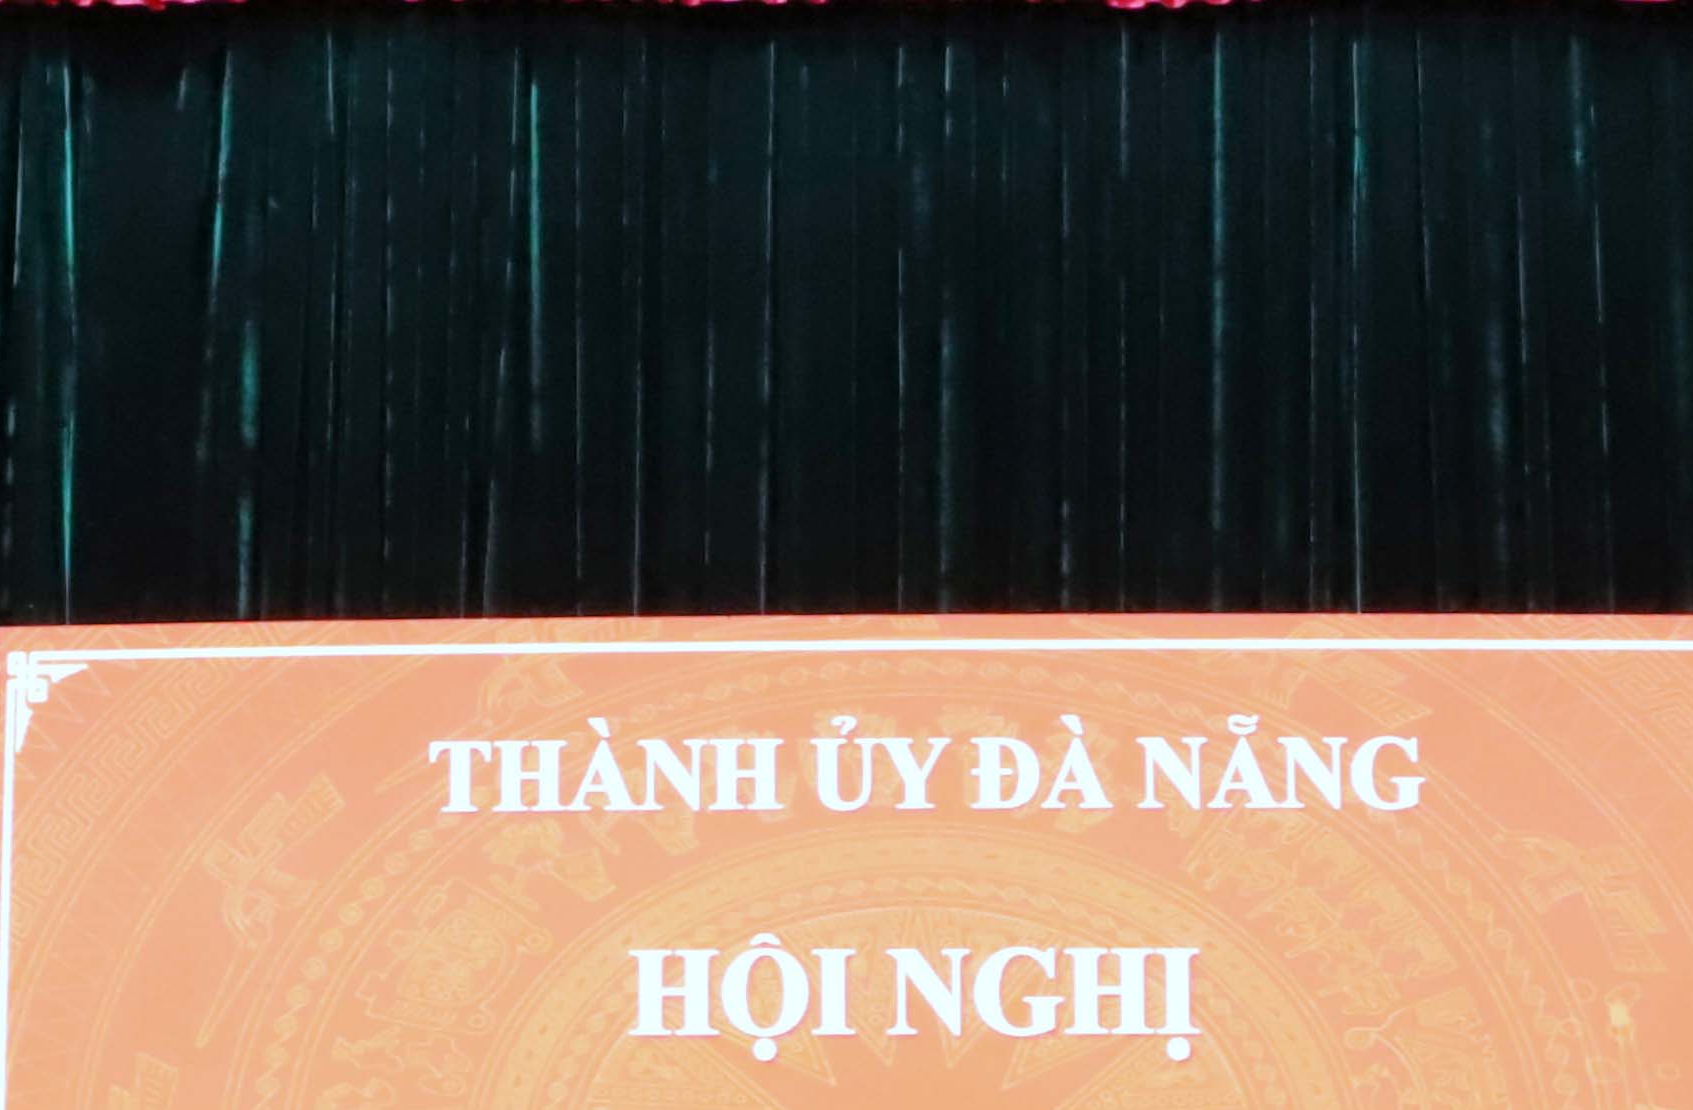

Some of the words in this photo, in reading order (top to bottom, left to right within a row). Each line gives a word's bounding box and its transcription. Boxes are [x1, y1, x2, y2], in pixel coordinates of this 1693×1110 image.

[428, 717, 784, 813] THÀNH
[810, 715, 950, 811] ỦY
[970, 714, 1113, 809] ĐÀ
[1137, 714, 1425, 811] NẴNG
[628, 933, 856, 1062] HỘI
[885, 946, 1200, 1062] NGHỊ
